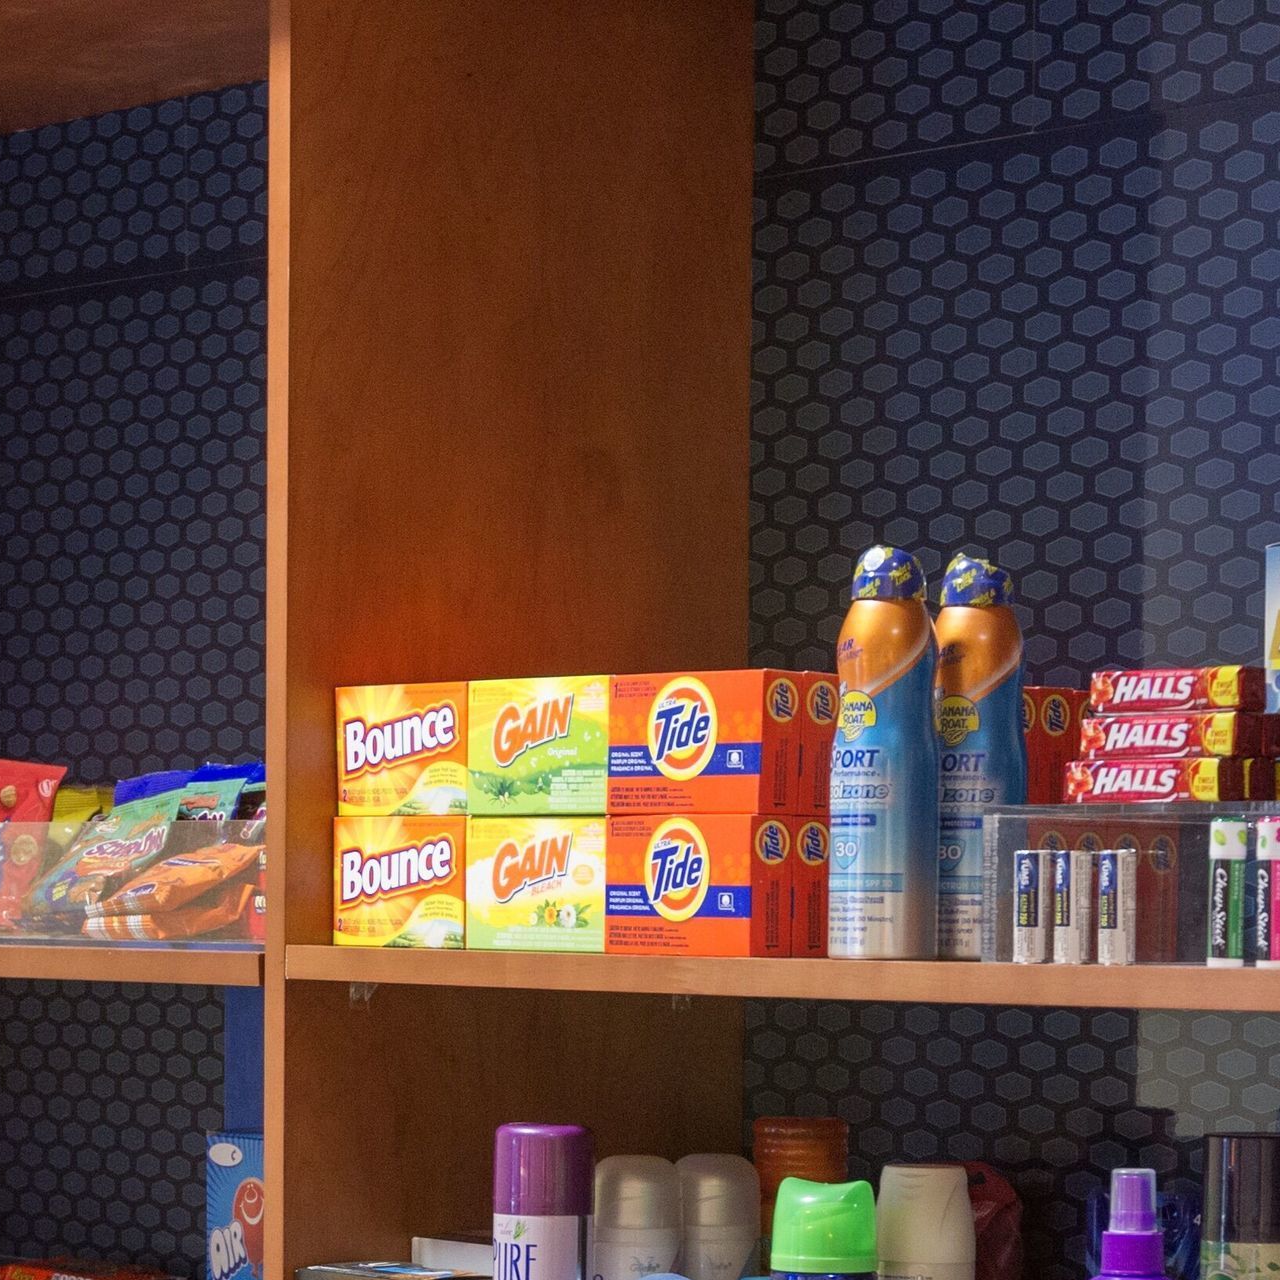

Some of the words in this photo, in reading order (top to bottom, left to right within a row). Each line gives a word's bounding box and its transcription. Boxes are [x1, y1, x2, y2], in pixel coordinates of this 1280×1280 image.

[775, 682, 793, 719] Tide
[816, 685, 834, 721] Tide
[1112, 675, 1194, 704] HALLS
[937, 705, 976, 718] BANANA
[940, 717, 966, 733] BOAT
[345, 705, 456, 773] Bounce
[494, 694, 573, 768] GAIN
[655, 702, 711, 762] Tide
[1105, 723, 1189, 751] HALLS
[548, 747, 578, 759] Original
[941, 752, 985, 771] ORT
[1092, 768, 1177, 796] HALLS
[763, 825, 784, 860] Tide
[804, 826, 825, 861] Tide
[835, 841, 857, 857] 30
[342, 840, 452, 901] Bounce
[493, 834, 572, 904] GAIN
[651, 845, 703, 903] Tide
[1020, 858, 1030, 886] TUMS
[1101, 859, 1111, 887] TUMS
[1213, 868, 1228, 949] ChapStick
[1257, 868, 1269, 950] ChapStick
